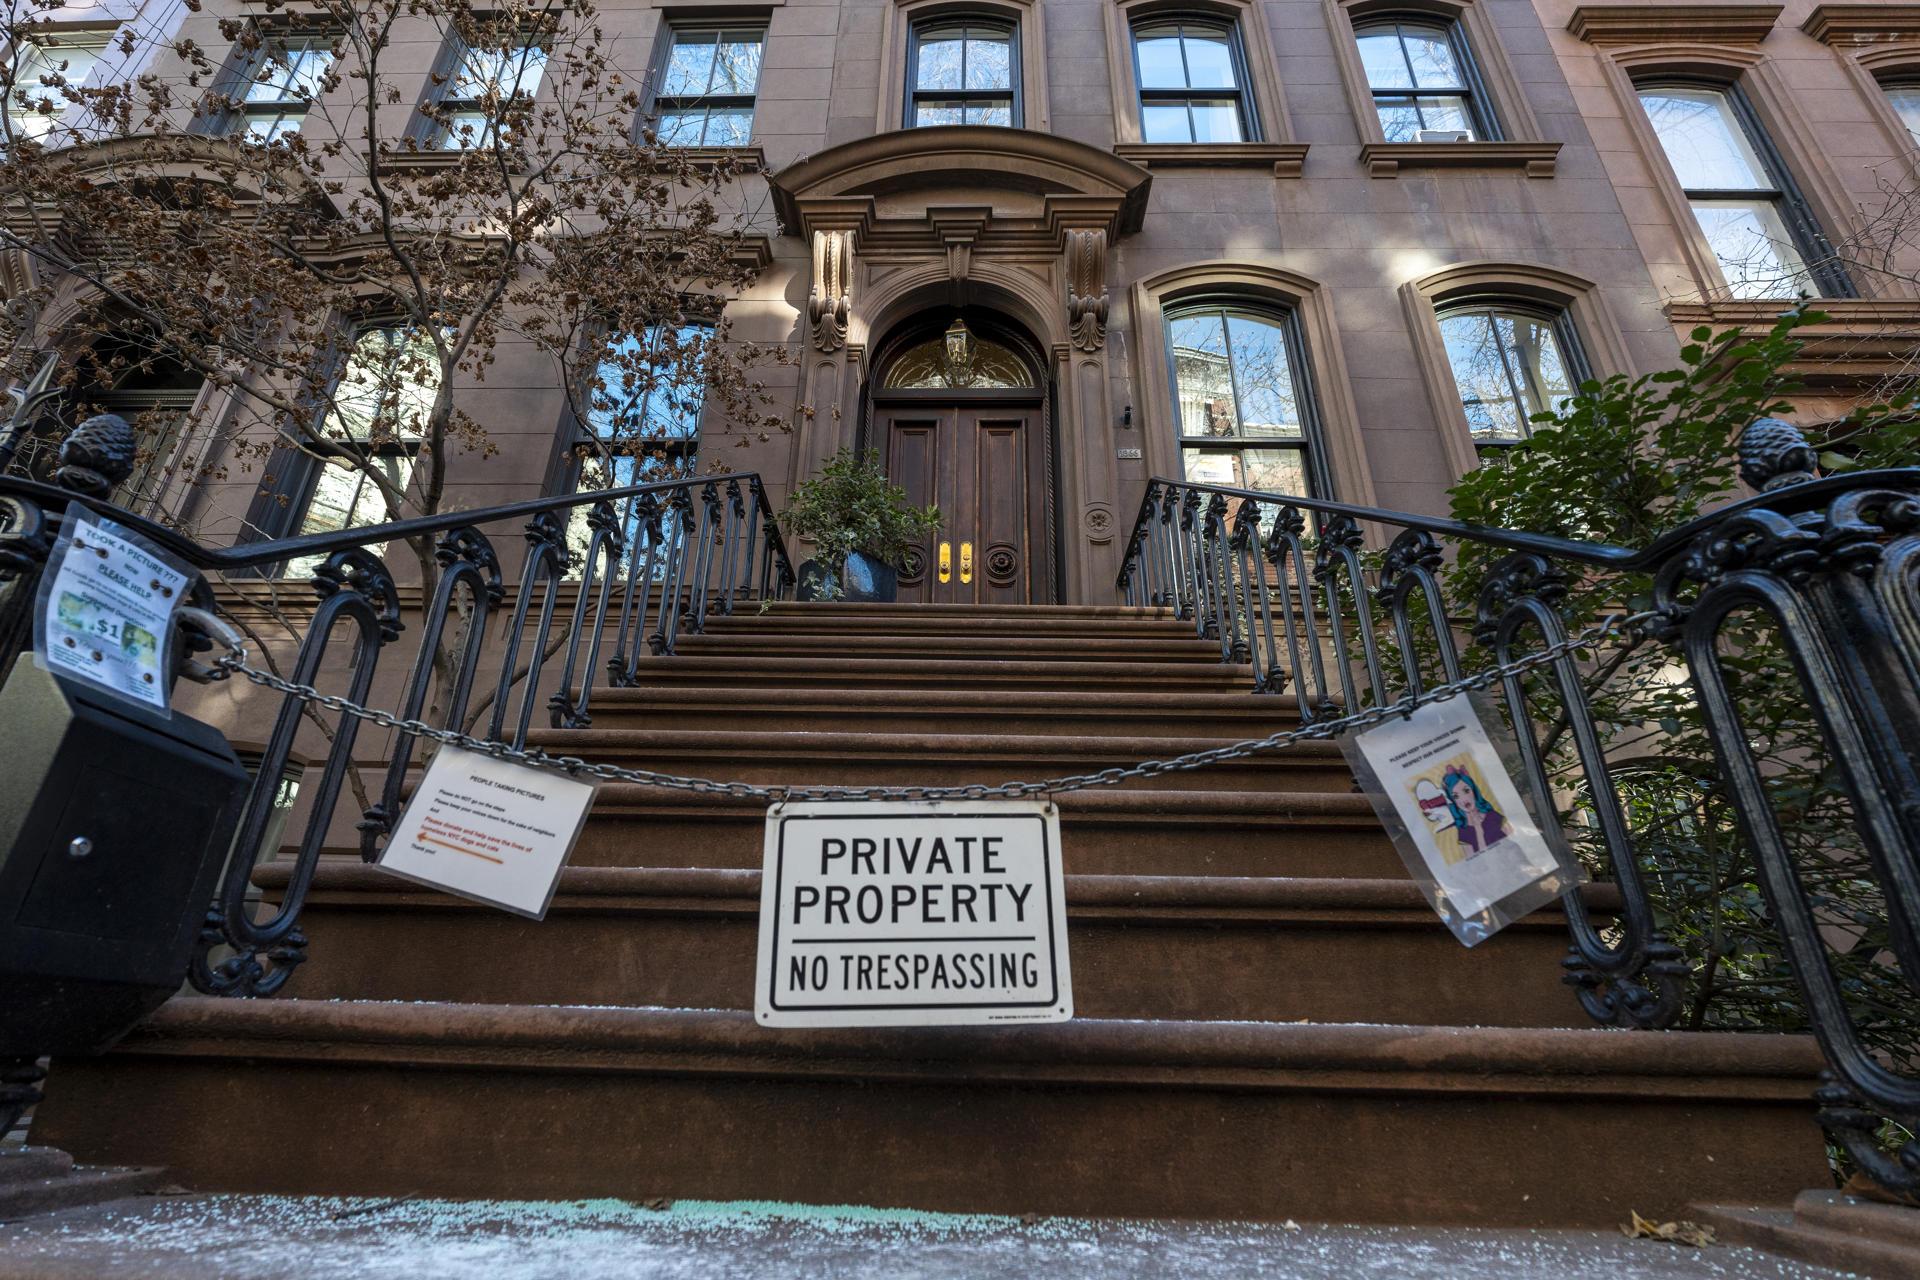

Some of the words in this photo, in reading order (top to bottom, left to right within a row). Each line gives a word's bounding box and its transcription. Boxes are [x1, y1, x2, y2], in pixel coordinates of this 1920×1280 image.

[86, 528, 116, 548] TOOK
[118, 544, 125, 552] A
[127, 548, 164, 575] PICTURE
[98, 563, 130, 588] PLEASE
[131, 584, 153, 600] HELP
[124, 563, 140, 575] NOW
[97, 618, 119, 639] $1
[470, 775, 493, 787] PEOPLE
[494, 782, 516, 794] TAKING
[516, 789, 545, 801] PICTURES
[424, 816, 442, 826] Please
[443, 821, 462, 832] donate
[463, 826, 474, 836] and
[475, 830, 487, 840] help
[501, 838, 511, 846] the
[448, 831, 461, 841] NYC
[476, 840, 487, 850] and
[411, 843, 424, 852] Thank
[821, 837, 1006, 875] PRIVATE
[793, 884, 1033, 925] PROPERTY
[789, 955, 829, 991] NO
[840, 952, 1038, 990] TRESPASSING
